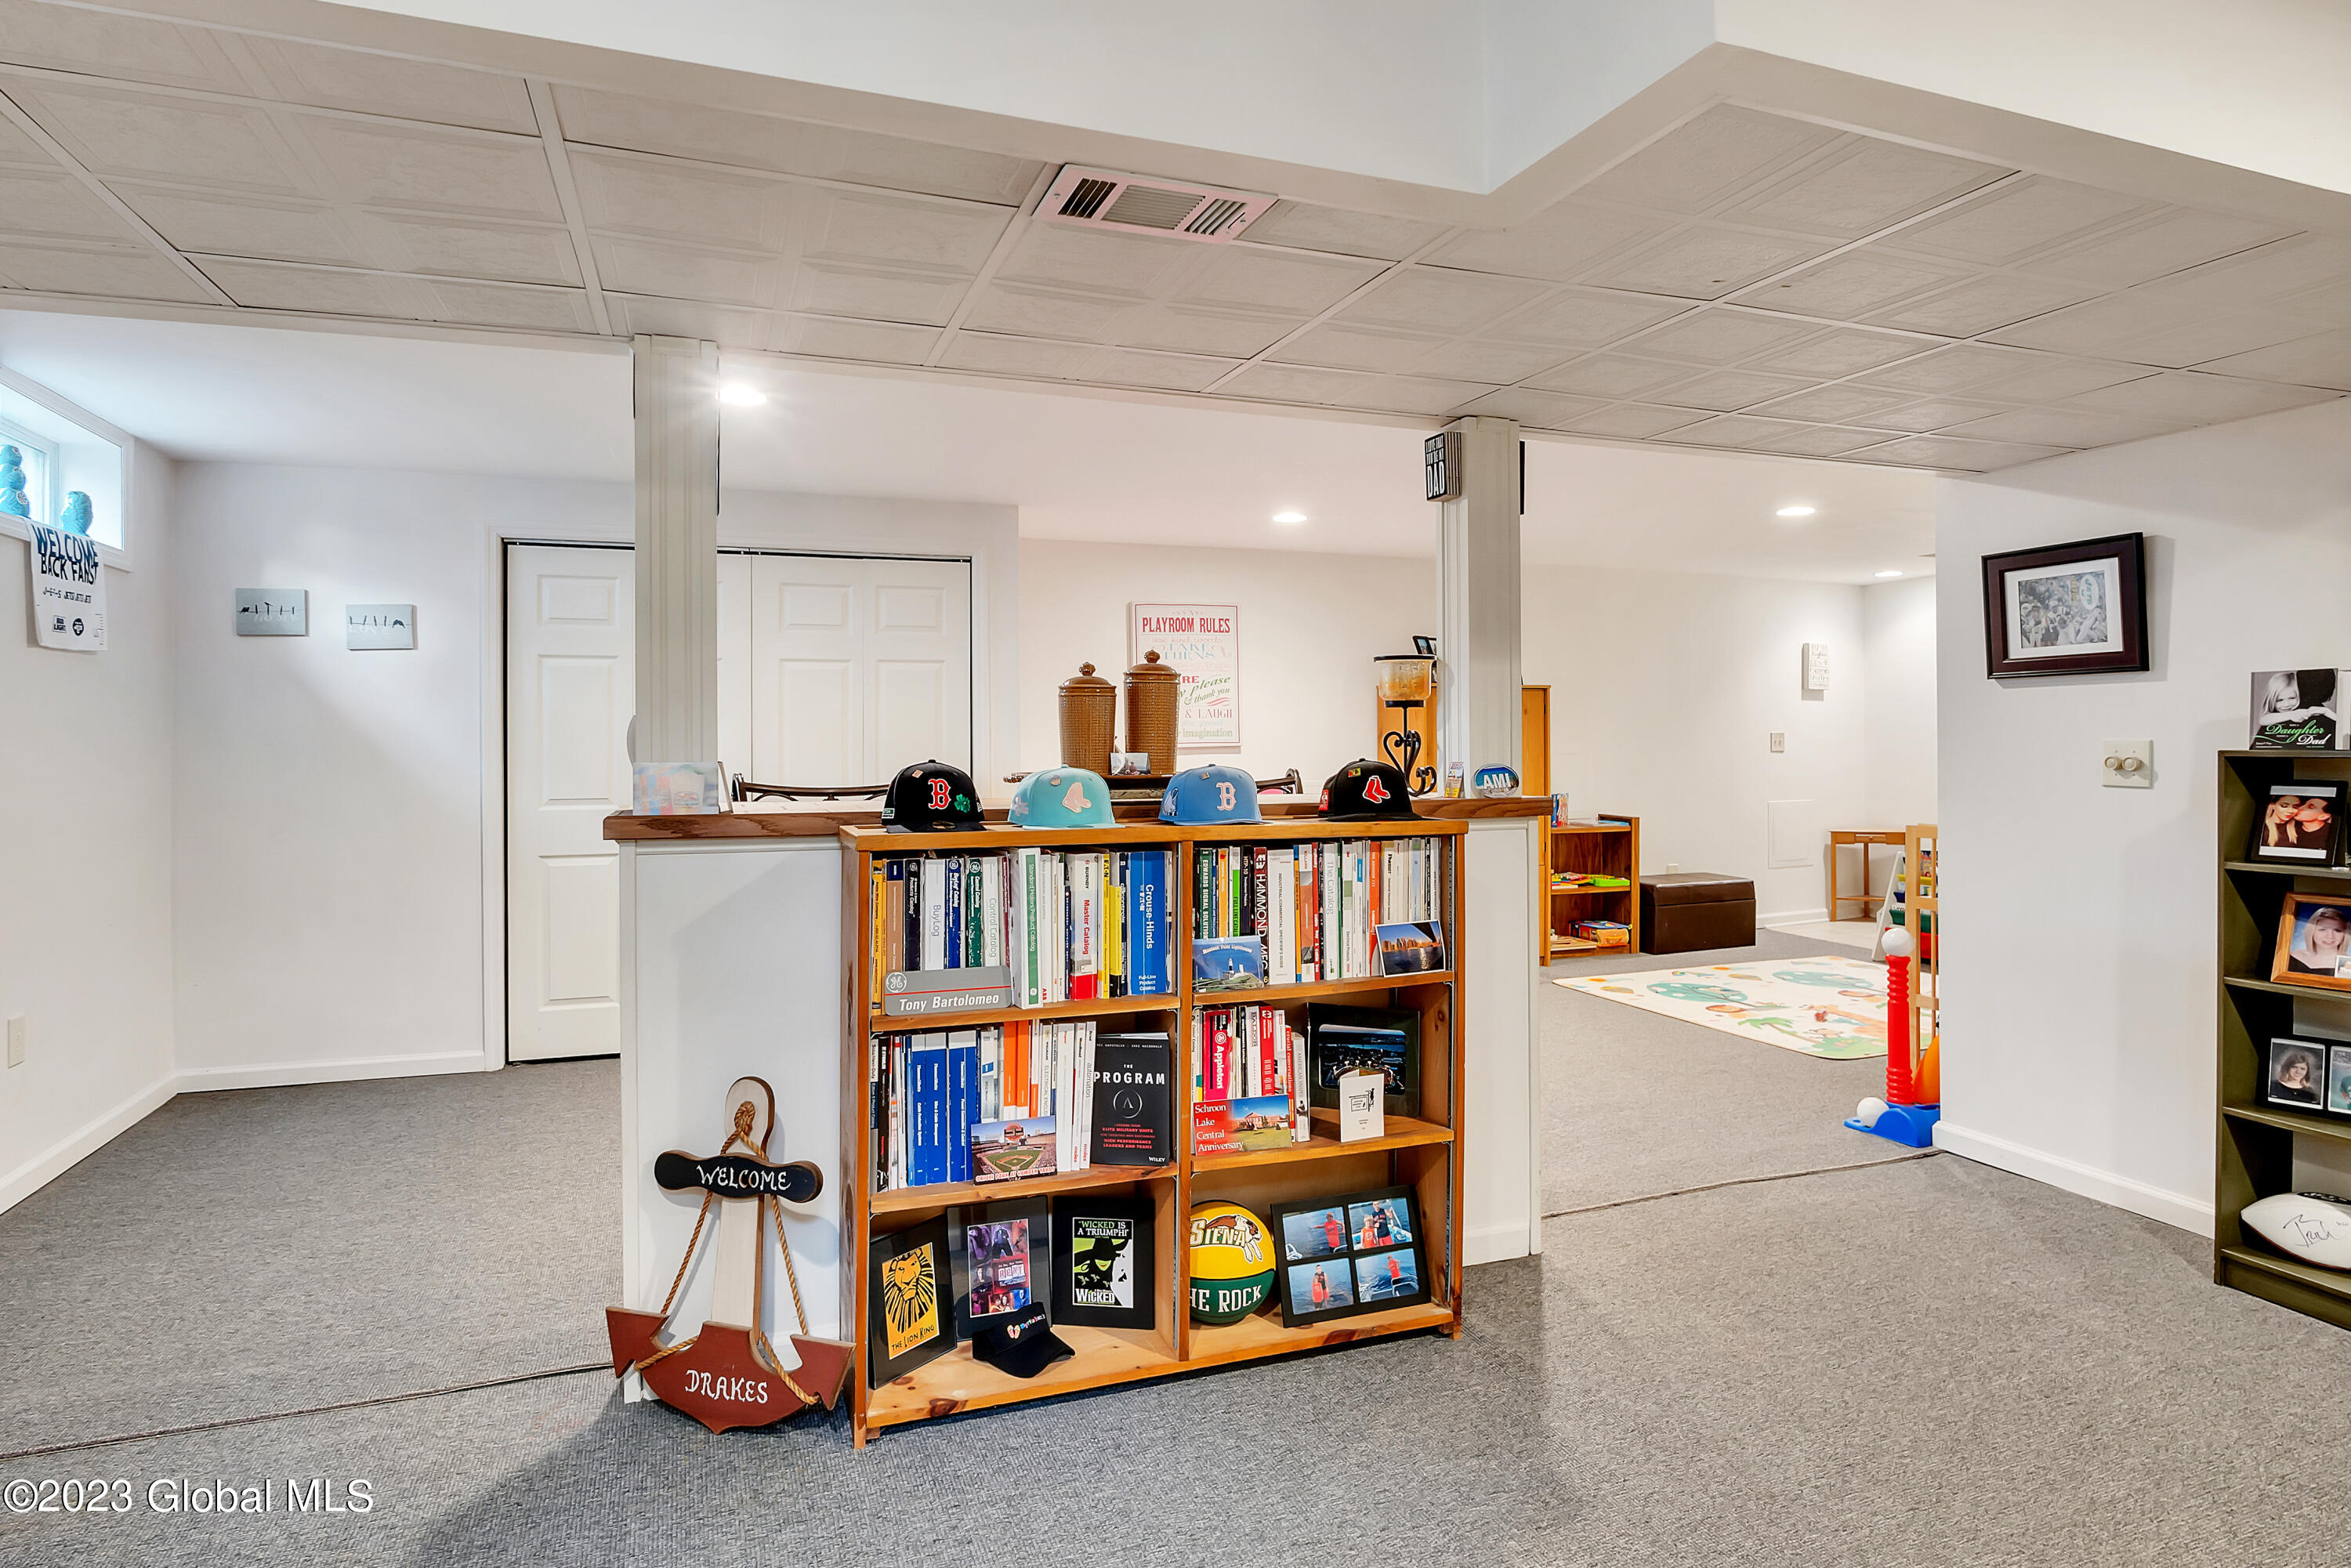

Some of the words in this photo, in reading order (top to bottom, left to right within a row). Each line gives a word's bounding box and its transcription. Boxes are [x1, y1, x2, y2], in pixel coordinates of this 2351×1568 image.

[1427, 461, 1445, 498] DAD
[31, 524, 99, 567] WELCOME
[41, 554, 68, 580] BACK
[1142, 617, 1194, 632] PLAYROOM
[1200, 617, 1230, 633] RULES
[1190, 677, 1230, 697] please
[1194, 689, 1215, 703] thank
[2264, 719, 2324, 744] Daughter
[2296, 734, 2331, 745] Dad
[928, 778, 952, 809] B
[1483, 773, 1512, 790] AMI
[1215, 782, 1237, 811] B
[1256, 873, 1267, 937] HAMMOND
[1327, 879, 1335, 915] Catalog
[932, 904, 941, 936] BuyLog
[1146, 884, 1155, 949] Crouse-Hinds
[989, 928, 998, 958] Catalog
[900, 998, 927, 1012] Tony
[932, 994, 999, 1009] Bartolomeo
[1094, 1071, 1165, 1085] PROGRAM
[1214, 1045, 1224, 1088] Appleton
[1195, 1104, 1226, 1114] Schroon
[1196, 1118, 1215, 1127] Lake
[1197, 1131, 1224, 1140] Central
[1198, 1142, 1244, 1152] Anniversary
[696, 1165, 791, 1191] WELCOME
[999, 1265, 1024, 1279] RENT
[1190, 1288, 1210, 1313] HE
[1218, 1284, 1262, 1313] ROCK
[892, 1341, 902, 1351] THE
[904, 1332, 919, 1348] LION
[919, 1323, 935, 1339] KING
[685, 1370, 769, 1404] DRAKES
